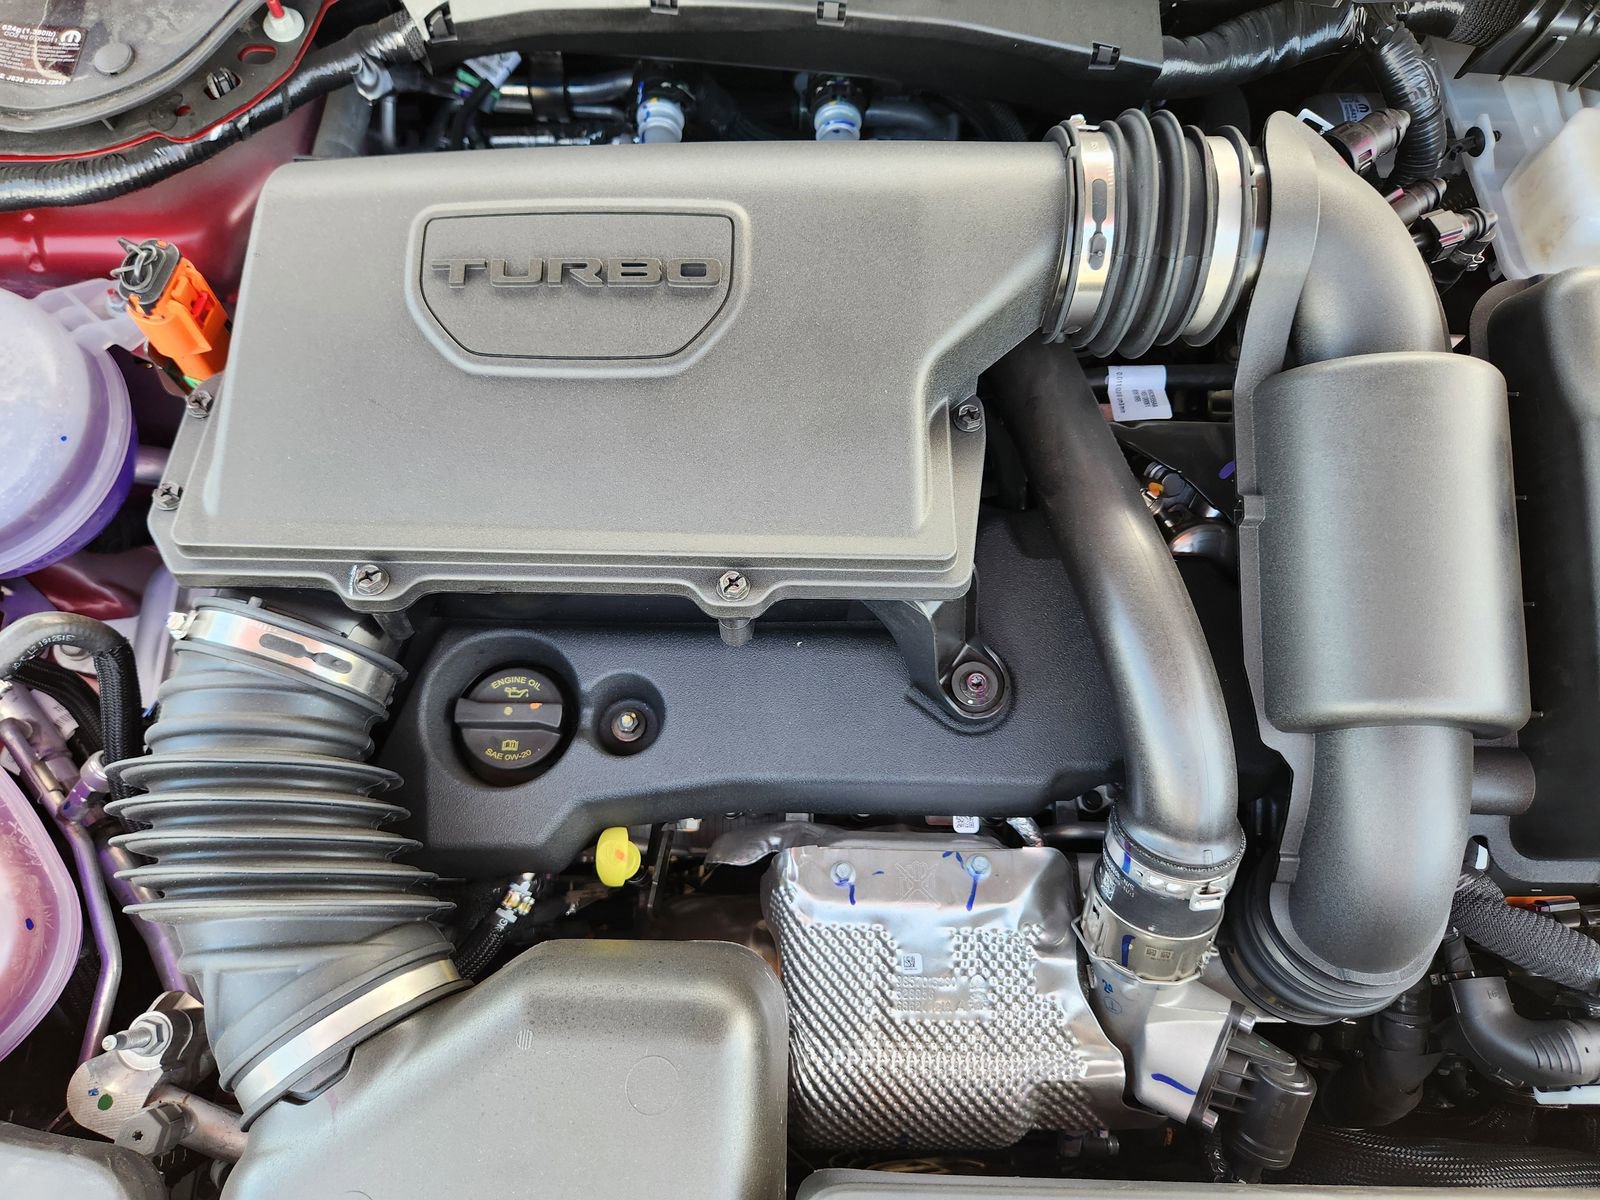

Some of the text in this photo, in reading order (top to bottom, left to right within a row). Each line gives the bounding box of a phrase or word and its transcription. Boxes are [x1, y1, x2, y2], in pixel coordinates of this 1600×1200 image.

[431, 257, 722, 288] TURBO
[491, 676, 542, 691] ENGINE OIL
[485, 748, 532, 761] SAE 0W-20
